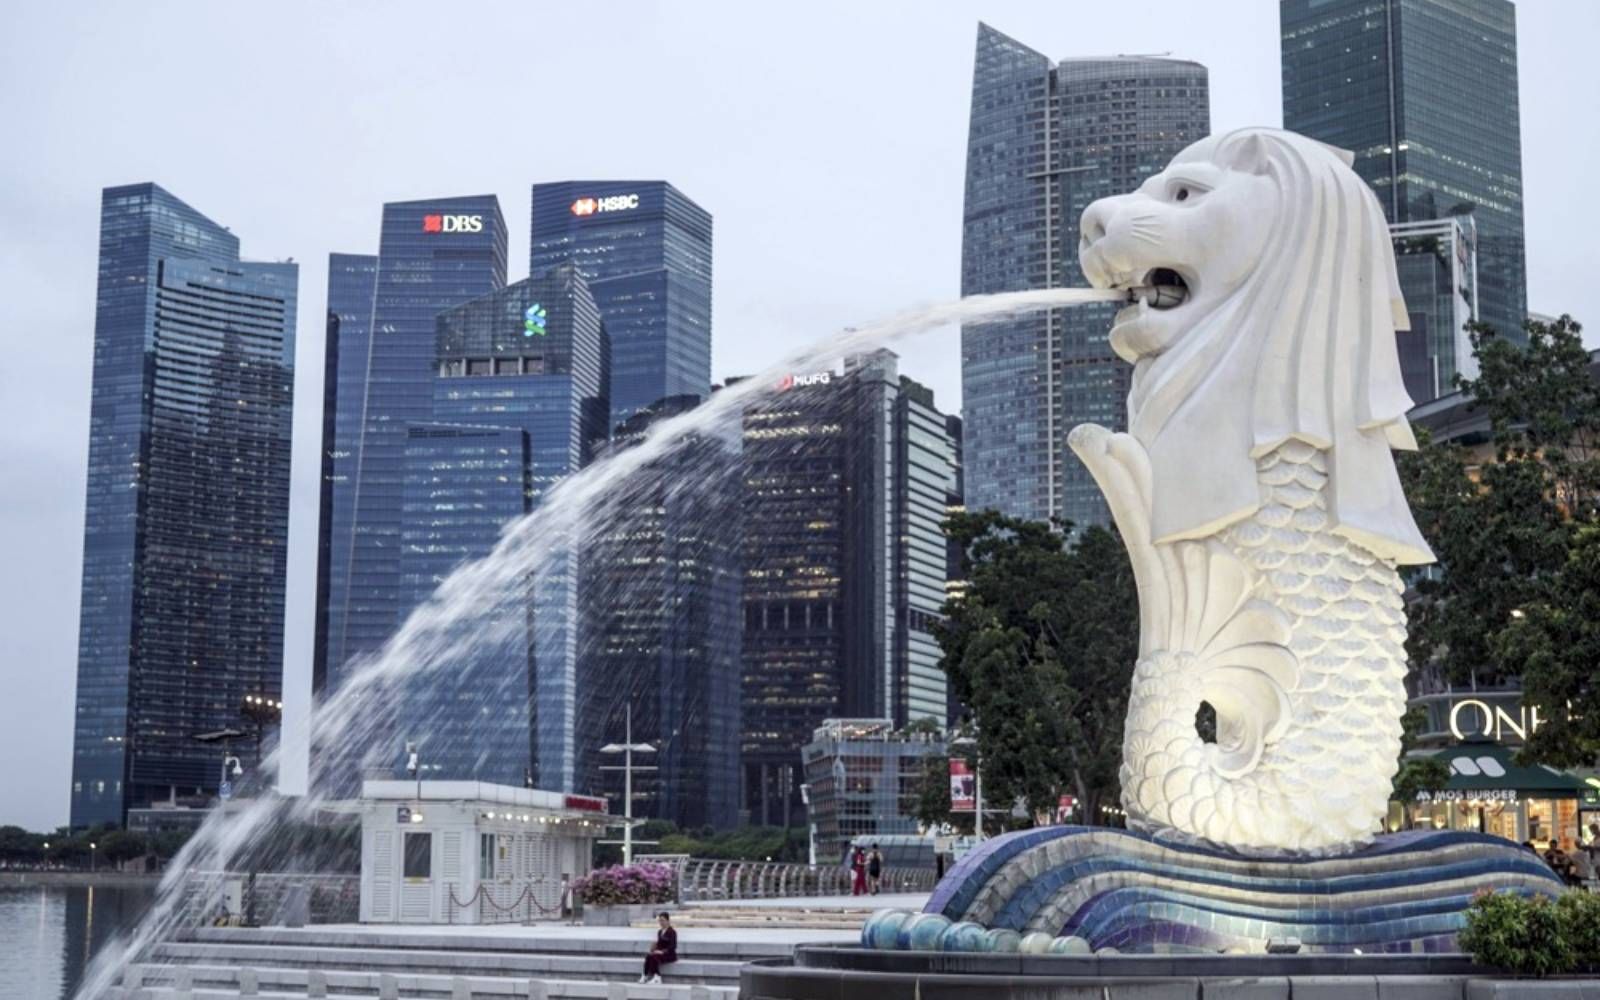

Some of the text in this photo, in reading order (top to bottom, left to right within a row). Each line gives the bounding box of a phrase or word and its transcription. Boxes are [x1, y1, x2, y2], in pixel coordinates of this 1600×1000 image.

[597, 194, 639, 212] HSBC
[443, 215, 482, 232] DBS
[793, 372, 830, 386] MUFG
[1434, 789, 1517, 800] MOS BURGER
